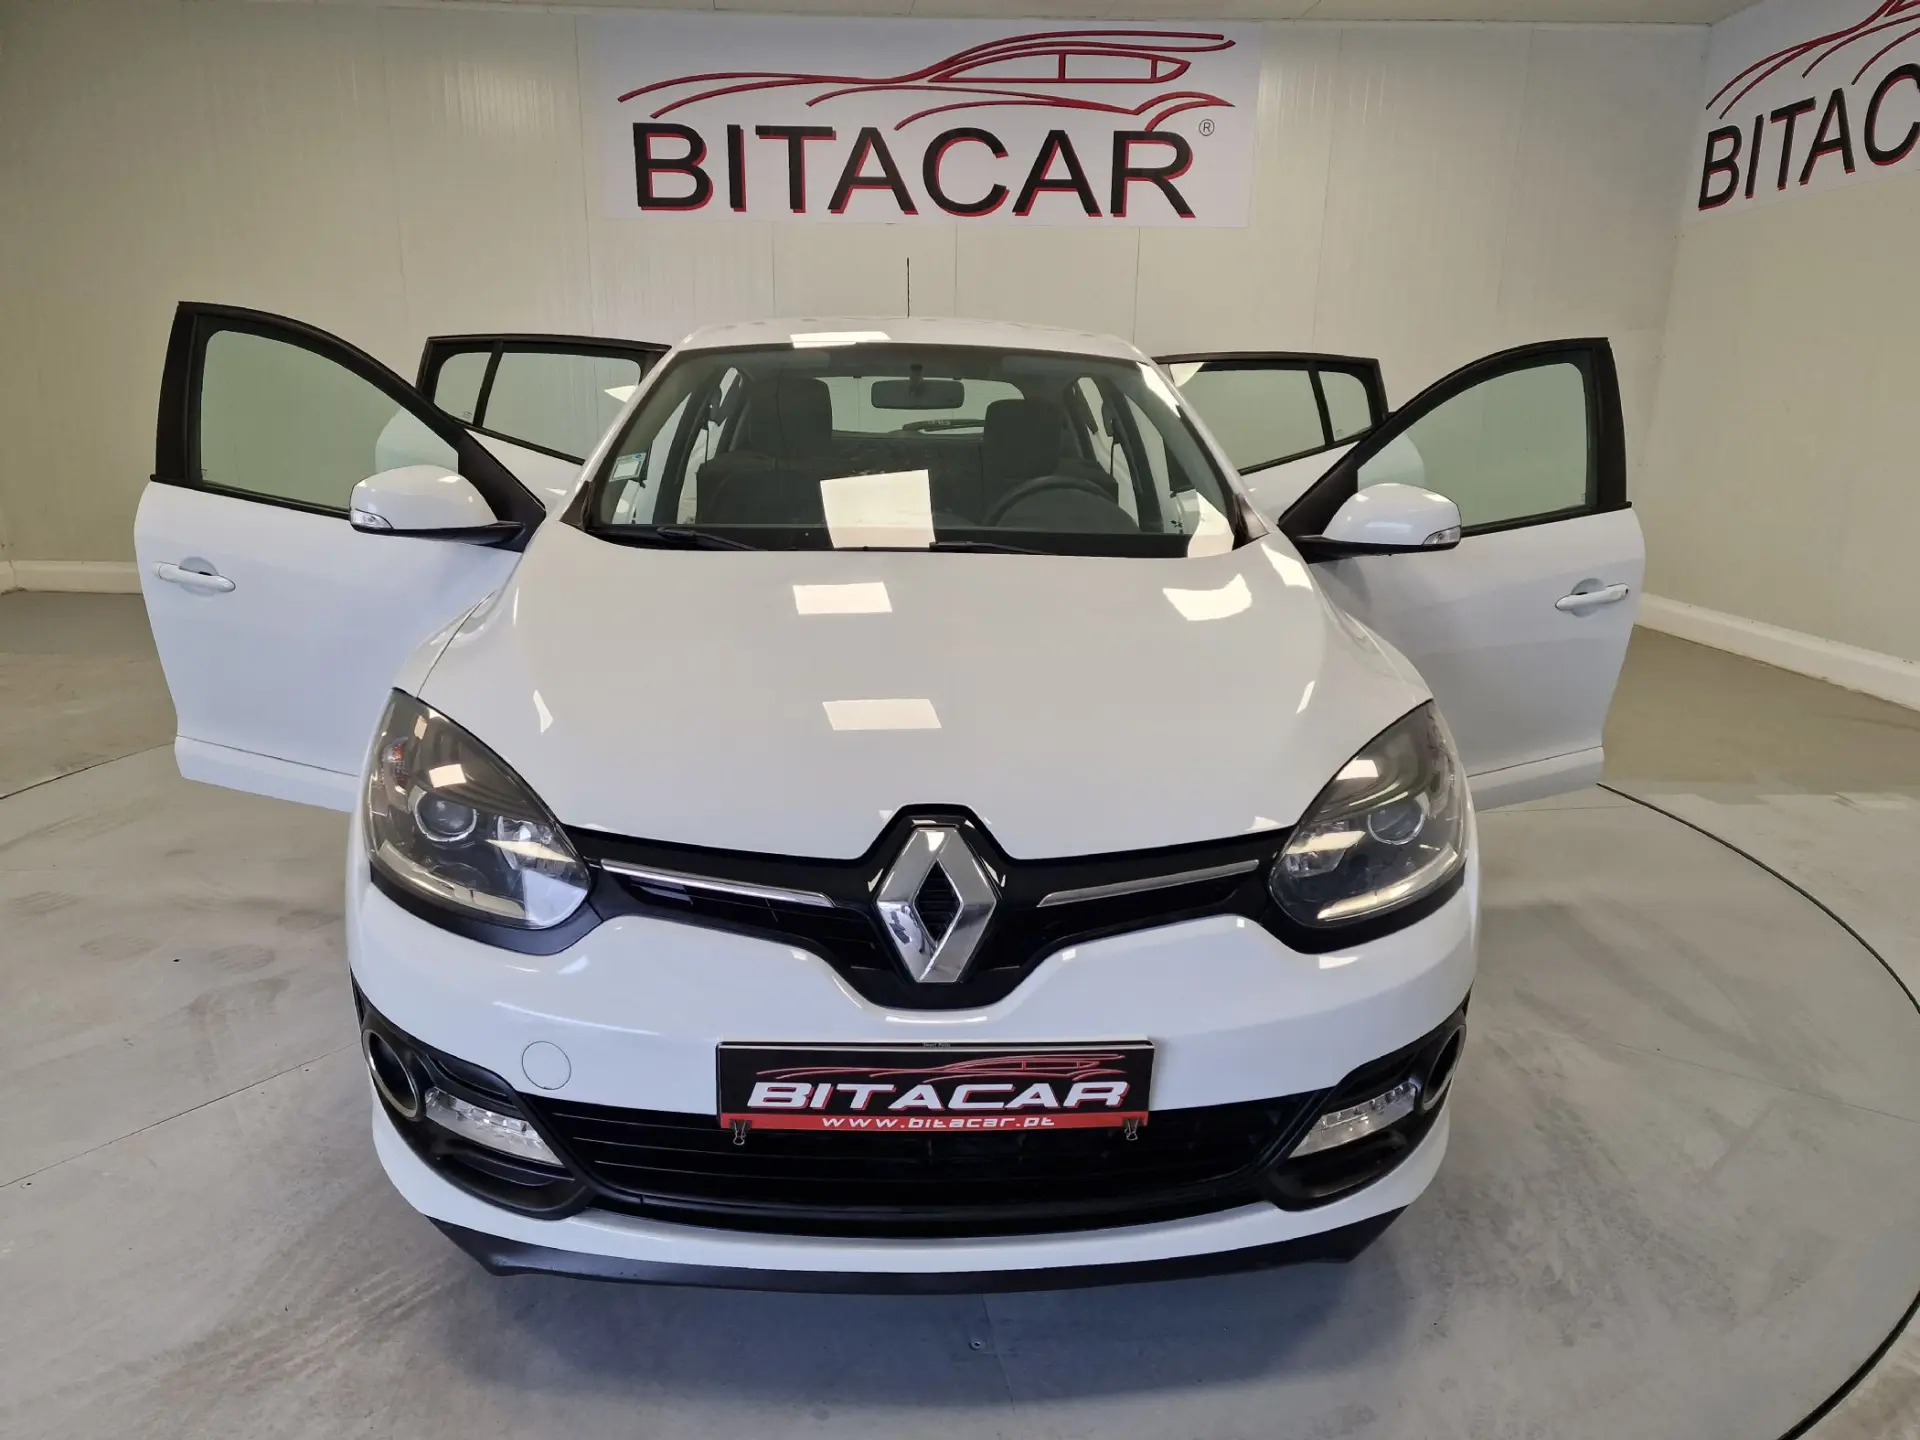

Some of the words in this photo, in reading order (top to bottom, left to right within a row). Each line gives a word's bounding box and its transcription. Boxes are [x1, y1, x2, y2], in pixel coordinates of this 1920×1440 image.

[632, 122, 1196, 219] BITACAR
[747, 1081, 1130, 1111] BITACAR
[822, 1117, 1055, 1129] www.bitacar.pt
